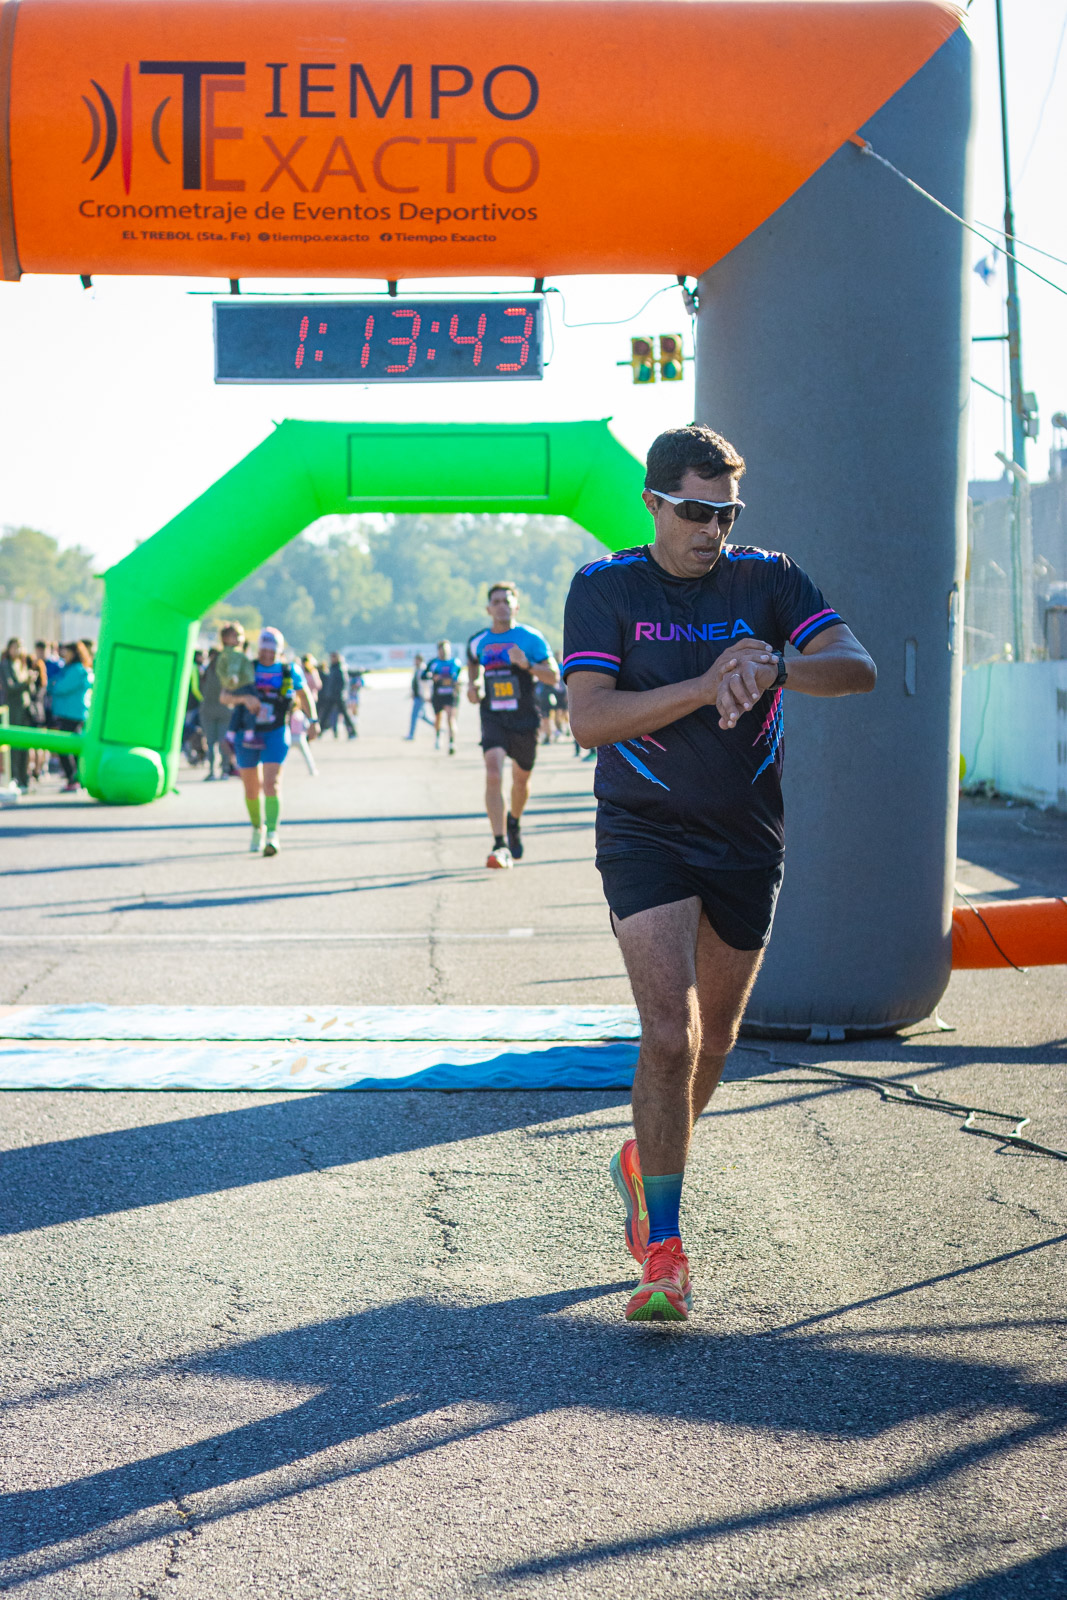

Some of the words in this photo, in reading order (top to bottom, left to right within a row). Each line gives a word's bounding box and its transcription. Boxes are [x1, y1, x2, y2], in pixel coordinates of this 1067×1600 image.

[139, 61, 540, 190] TIEMPO
[205, 79, 541, 193] EXACTO
[79, 200, 248, 224] Cronometraje
[254, 201, 285, 220] de
[293, 202, 391, 221] Eventos
[400, 202, 538, 224] Deportivos
[122, 231, 137, 240] EL
[141, 231, 193, 240] TREBOL
[197, 231, 227, 242] (Sta.
[231, 232, 251, 242] Fe)
[272, 233, 370, 244] tiempo.exacto
[394, 233, 447, 244] Tiempo
[451, 233, 497, 243] Exacto
[635, 618, 755, 642] RUNNEA
